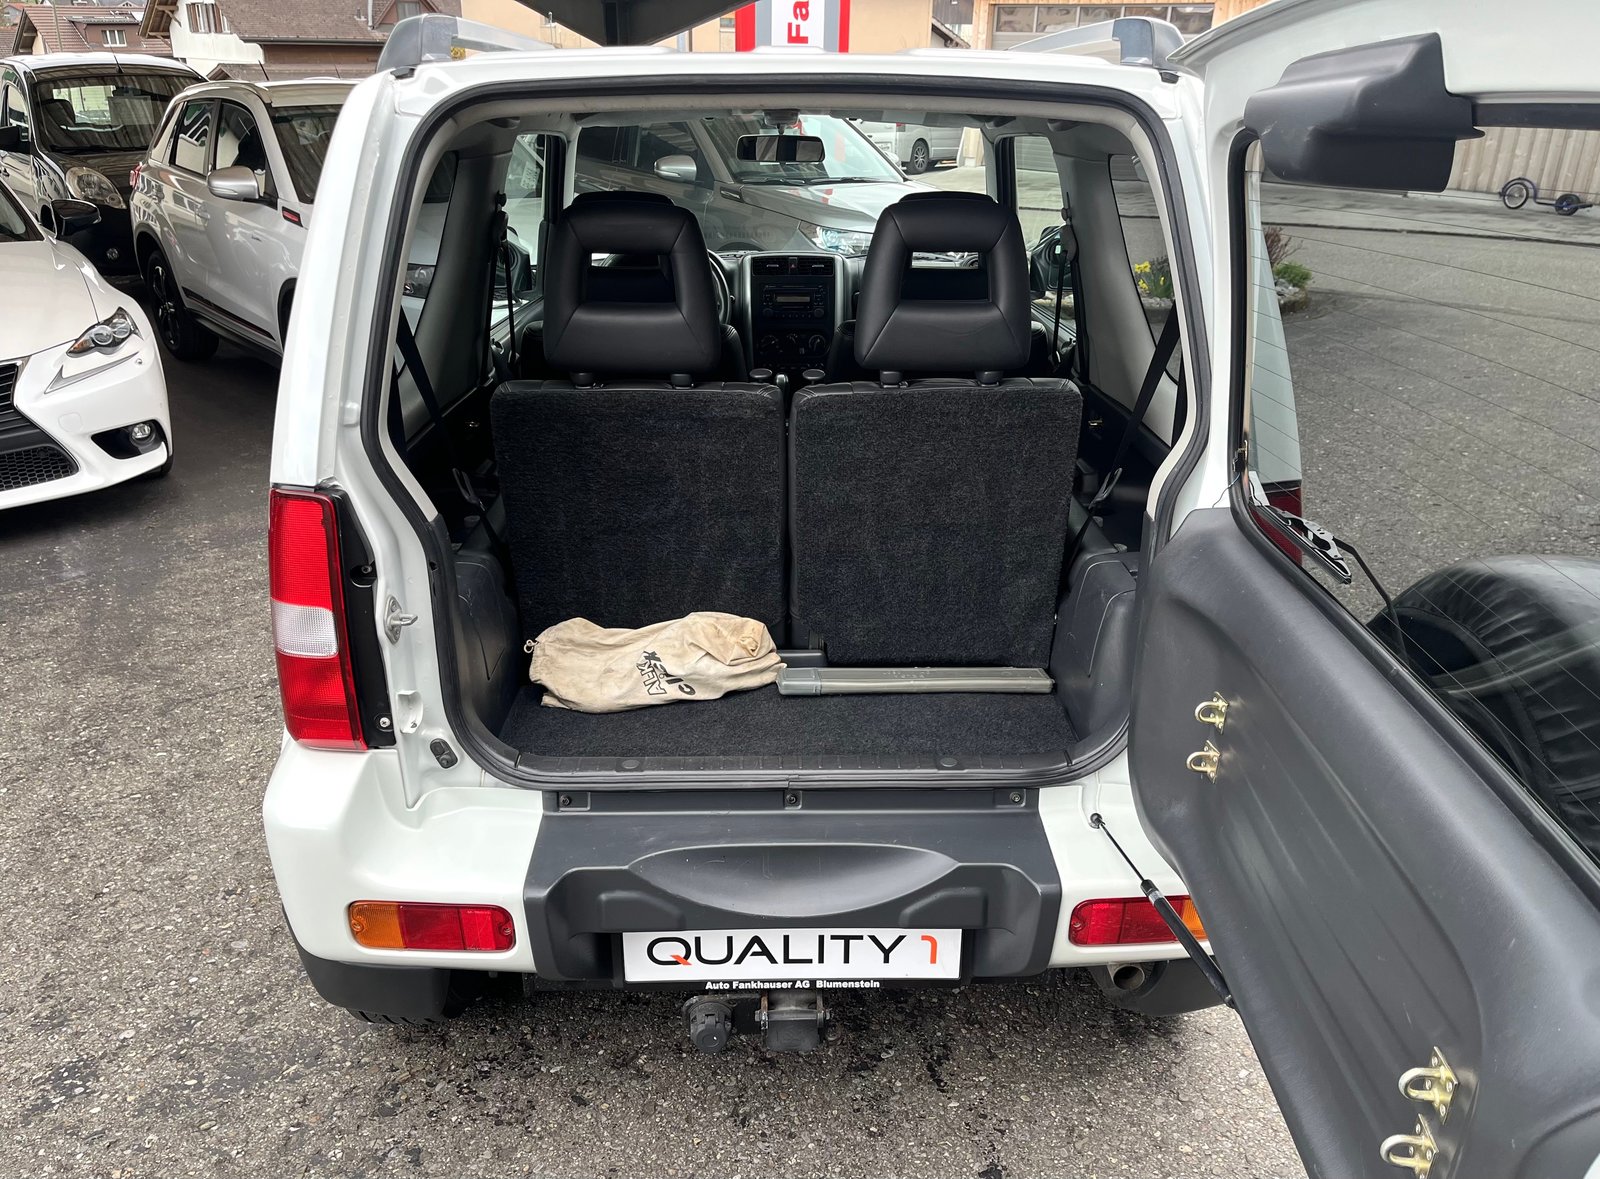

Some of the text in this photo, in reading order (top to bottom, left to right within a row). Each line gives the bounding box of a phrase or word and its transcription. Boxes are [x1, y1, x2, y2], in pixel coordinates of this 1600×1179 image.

[647, 934, 907, 966] QUALITY
[705, 979, 880, 990] Auto Fankhauser AG Blumenstein
